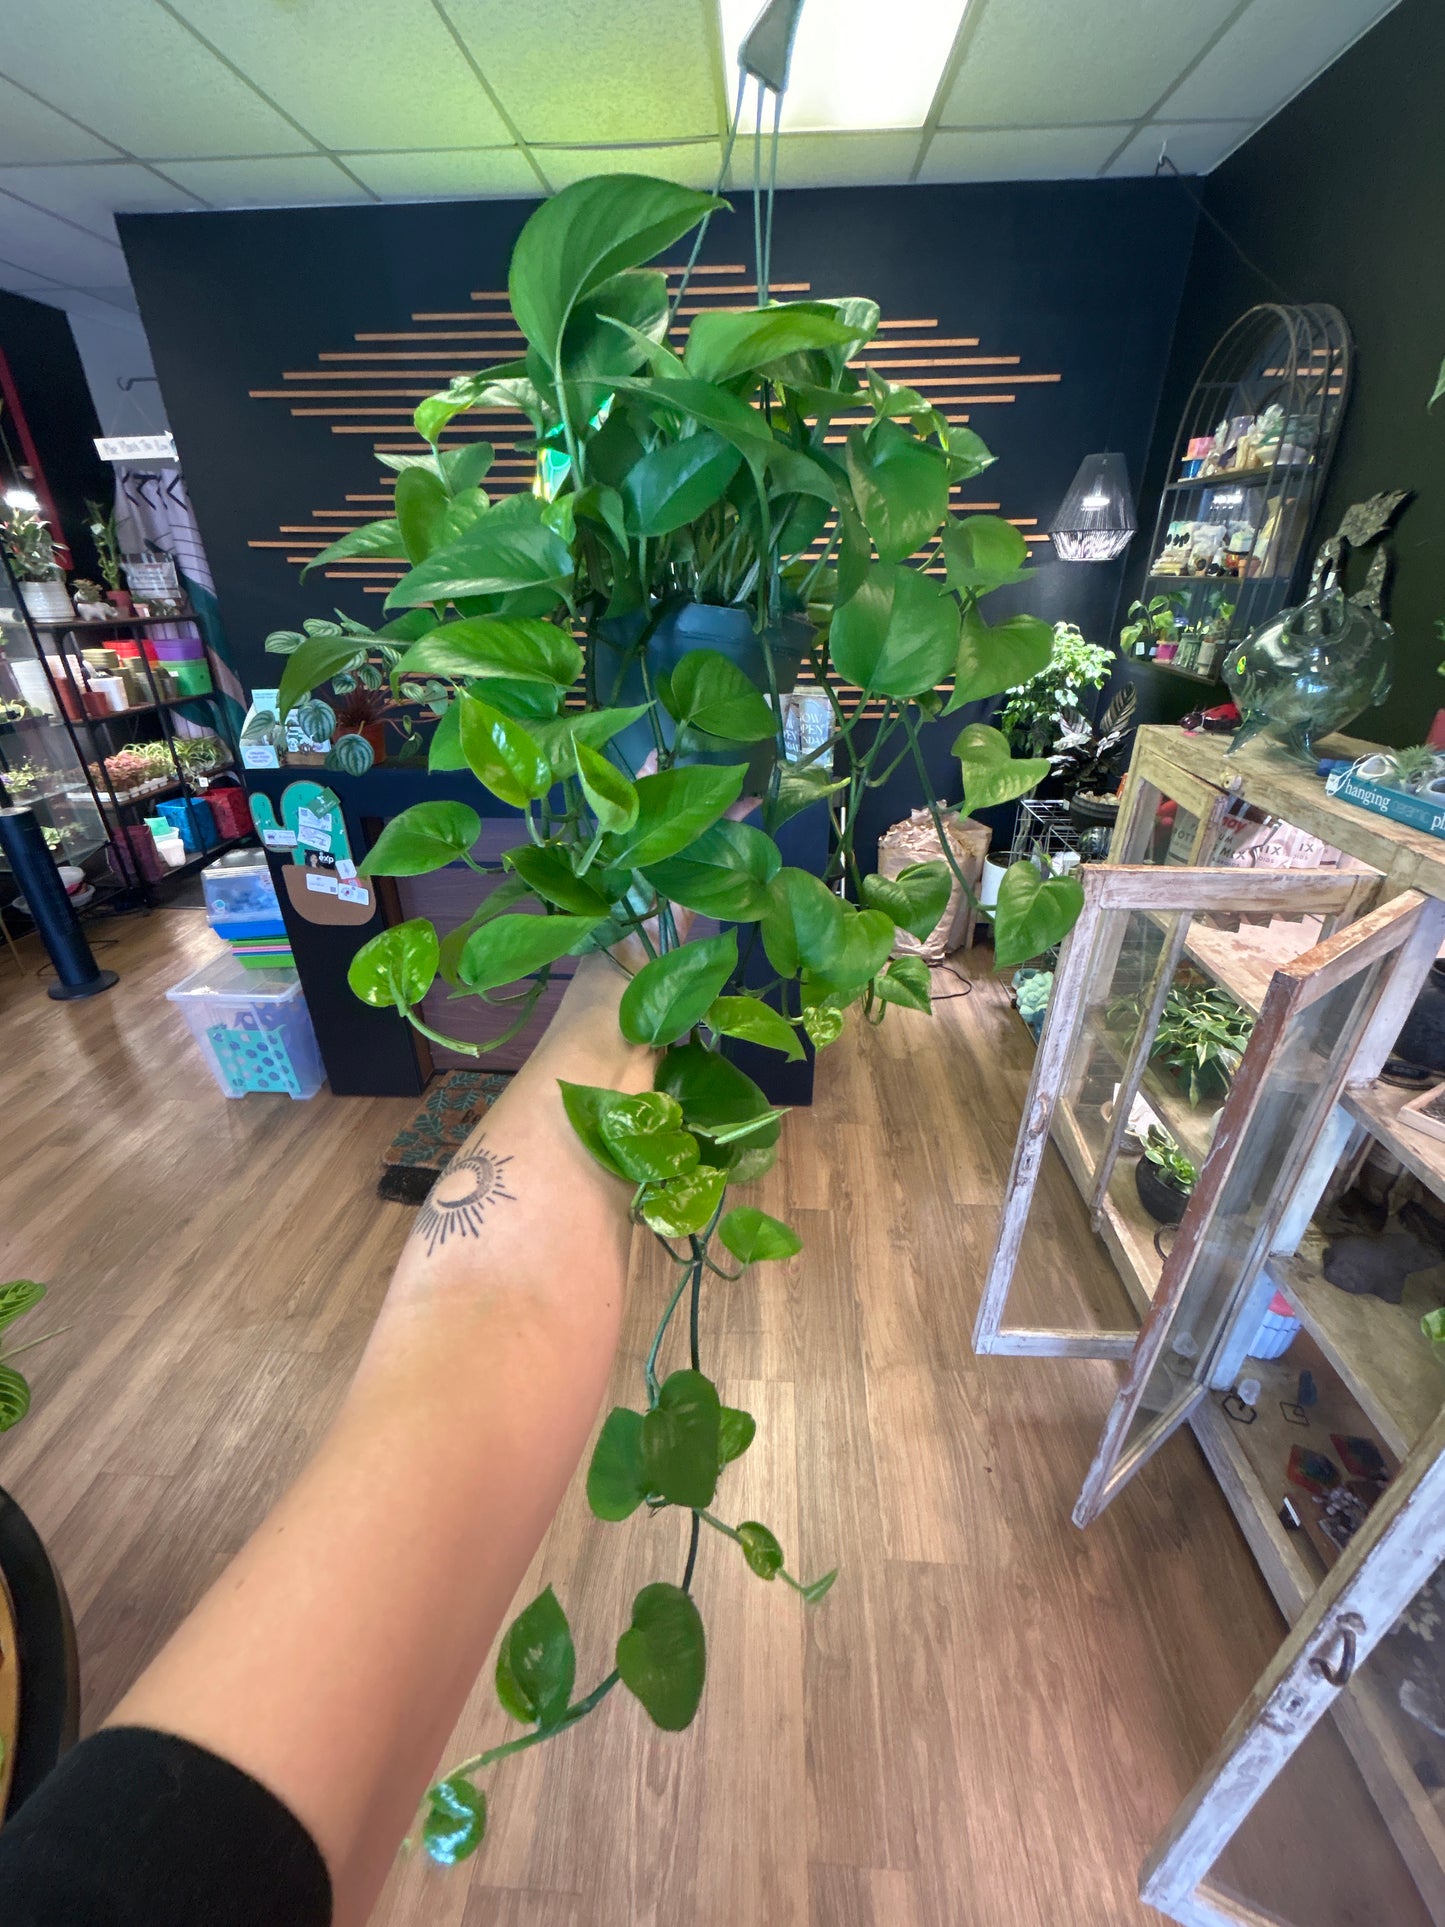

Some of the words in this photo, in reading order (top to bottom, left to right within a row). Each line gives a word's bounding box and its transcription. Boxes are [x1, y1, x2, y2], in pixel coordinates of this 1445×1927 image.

[1345, 778, 1390, 812] hanging
[1431, 811, 1445, 830] pl
[1219, 847, 1246, 860] MIX
[1299, 843, 1314, 853] IX
[460, 1109, 482, 1124] Be
